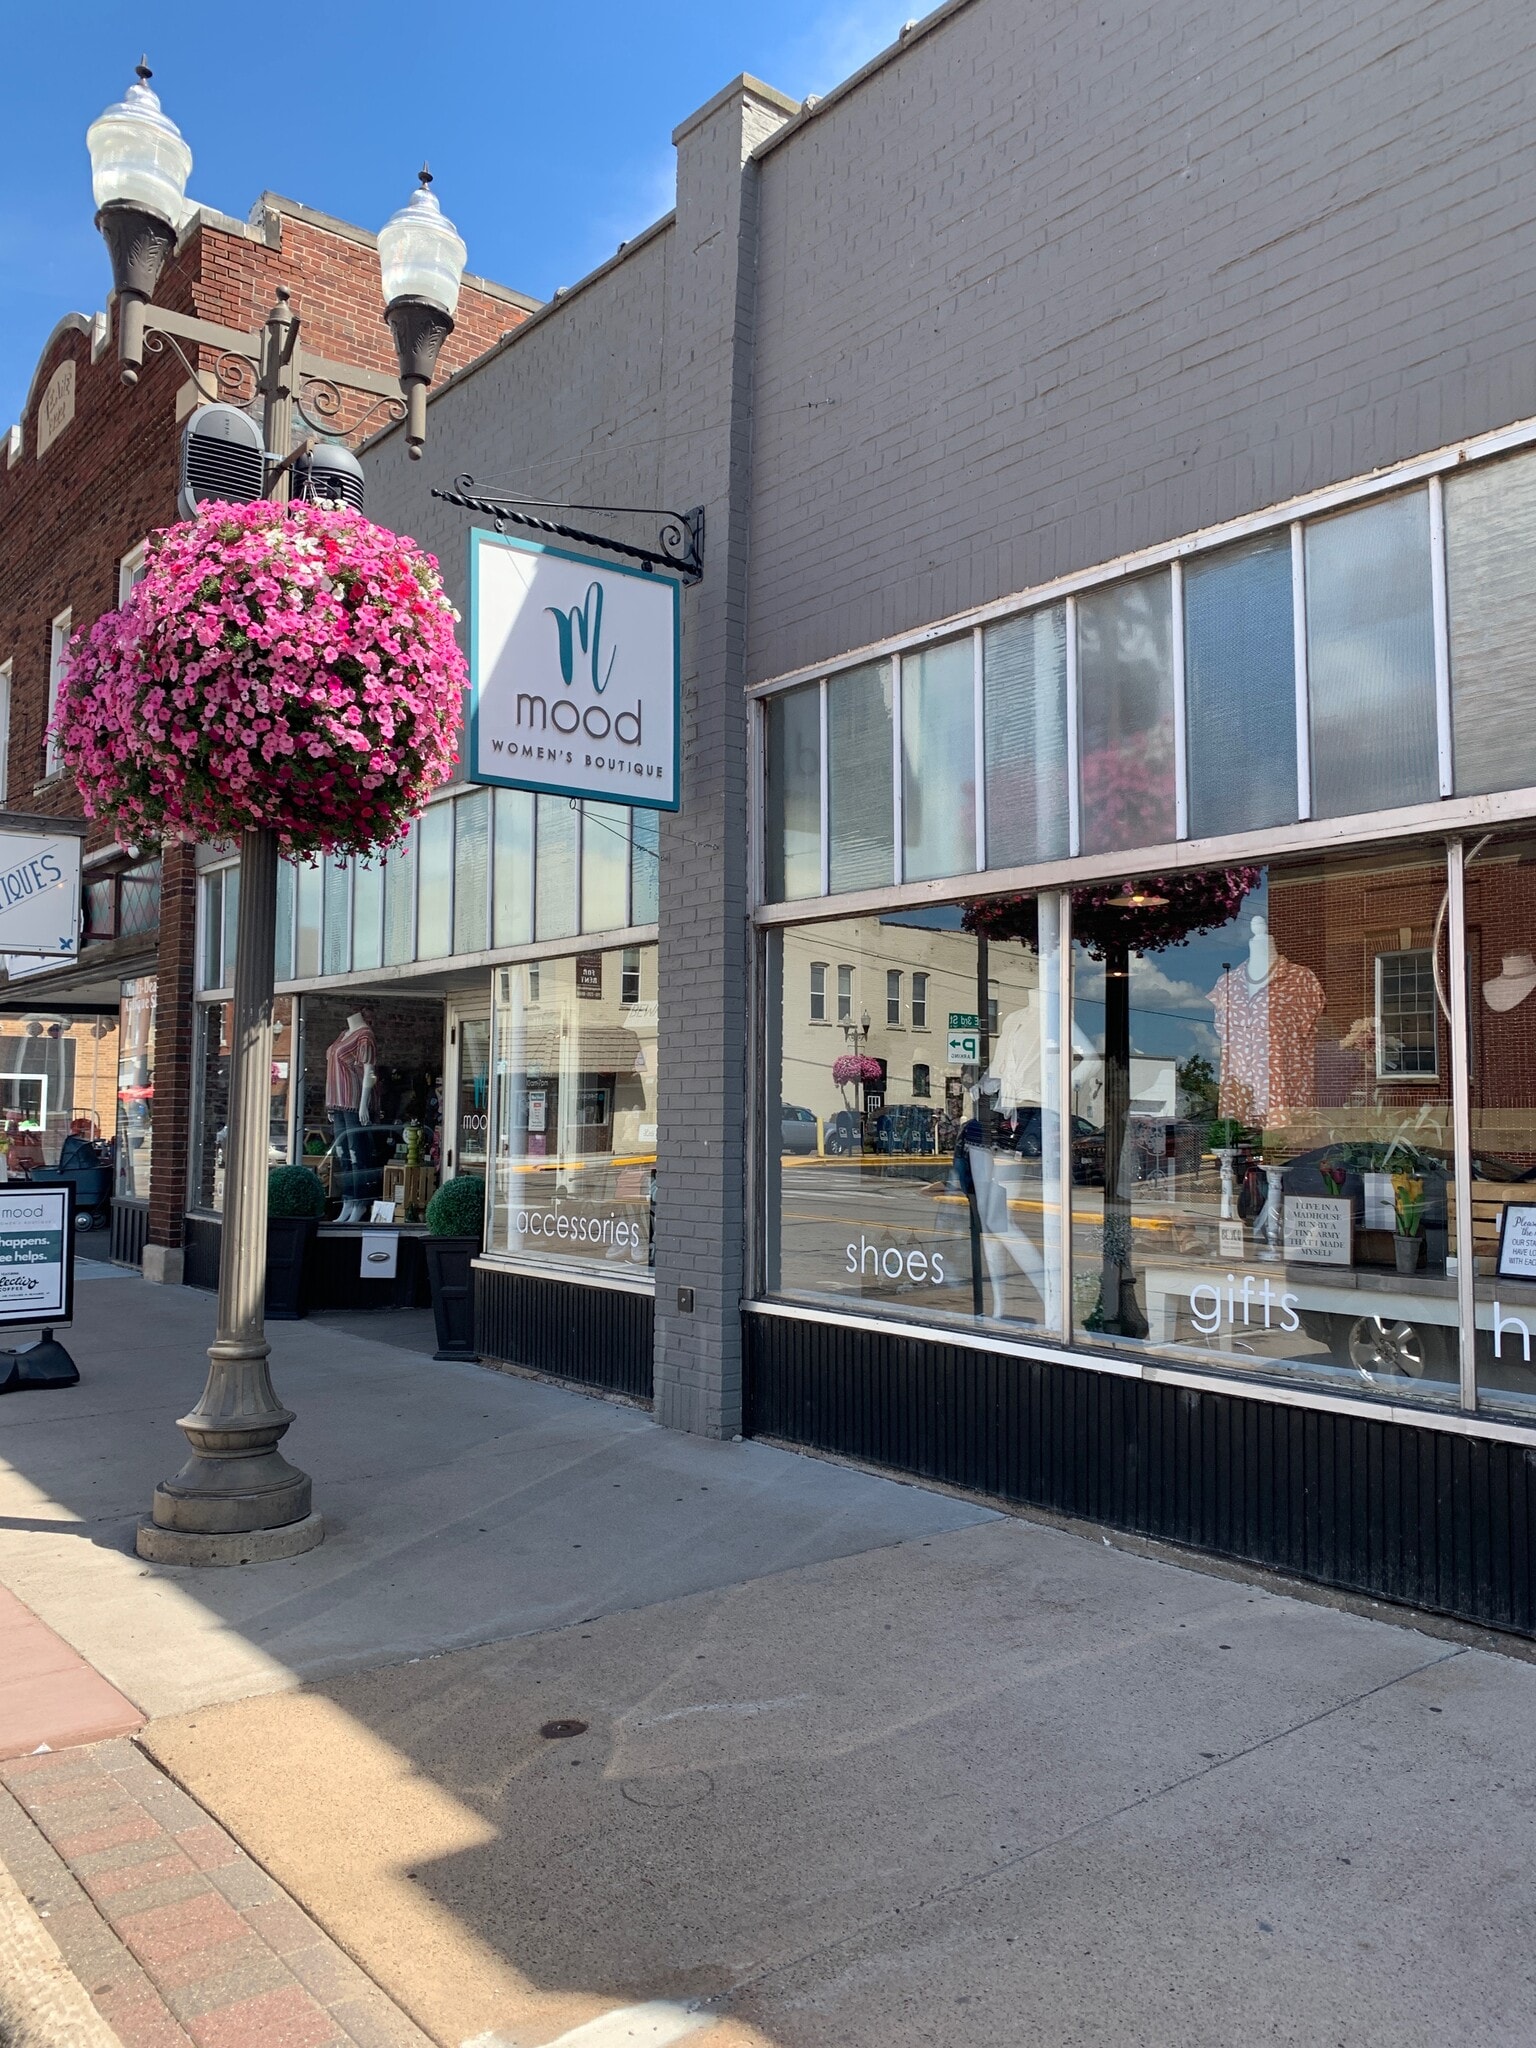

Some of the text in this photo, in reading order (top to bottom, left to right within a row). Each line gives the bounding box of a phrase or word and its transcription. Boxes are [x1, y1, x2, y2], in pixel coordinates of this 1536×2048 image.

[515, 693, 642, 747] mood
[491, 739, 663, 779] WOMEN'S BOUTIQUE
[0, 855, 62, 909] IQUES
[2, 1204, 44, 1218] mood
[1301, 1203, 1319, 1211] LIVE
[1293, 1212, 1342, 1221] MADHOUSE
[517, 1211, 639, 1247] accessories
[1297, 1220, 1315, 1228] RUN
[1318, 1221, 1328, 1229] BY
[1294, 1229, 1341, 1239] TINY ARMY
[0, 1236, 50, 1249] happens.
[1290, 1238, 1313, 1246] THAT
[1320, 1240, 1345, 1249] MADE
[14, 1250, 48, 1263] helps.
[1300, 1248, 1333, 1257] MYSELF
[1513, 1248, 1528, 1256] HAVE
[846, 1235, 944, 1284] shoes
[1509, 1257, 1523, 1265] WITH
[1190, 1273, 1300, 1334] gifts
[1493, 1301, 1530, 1362] h
